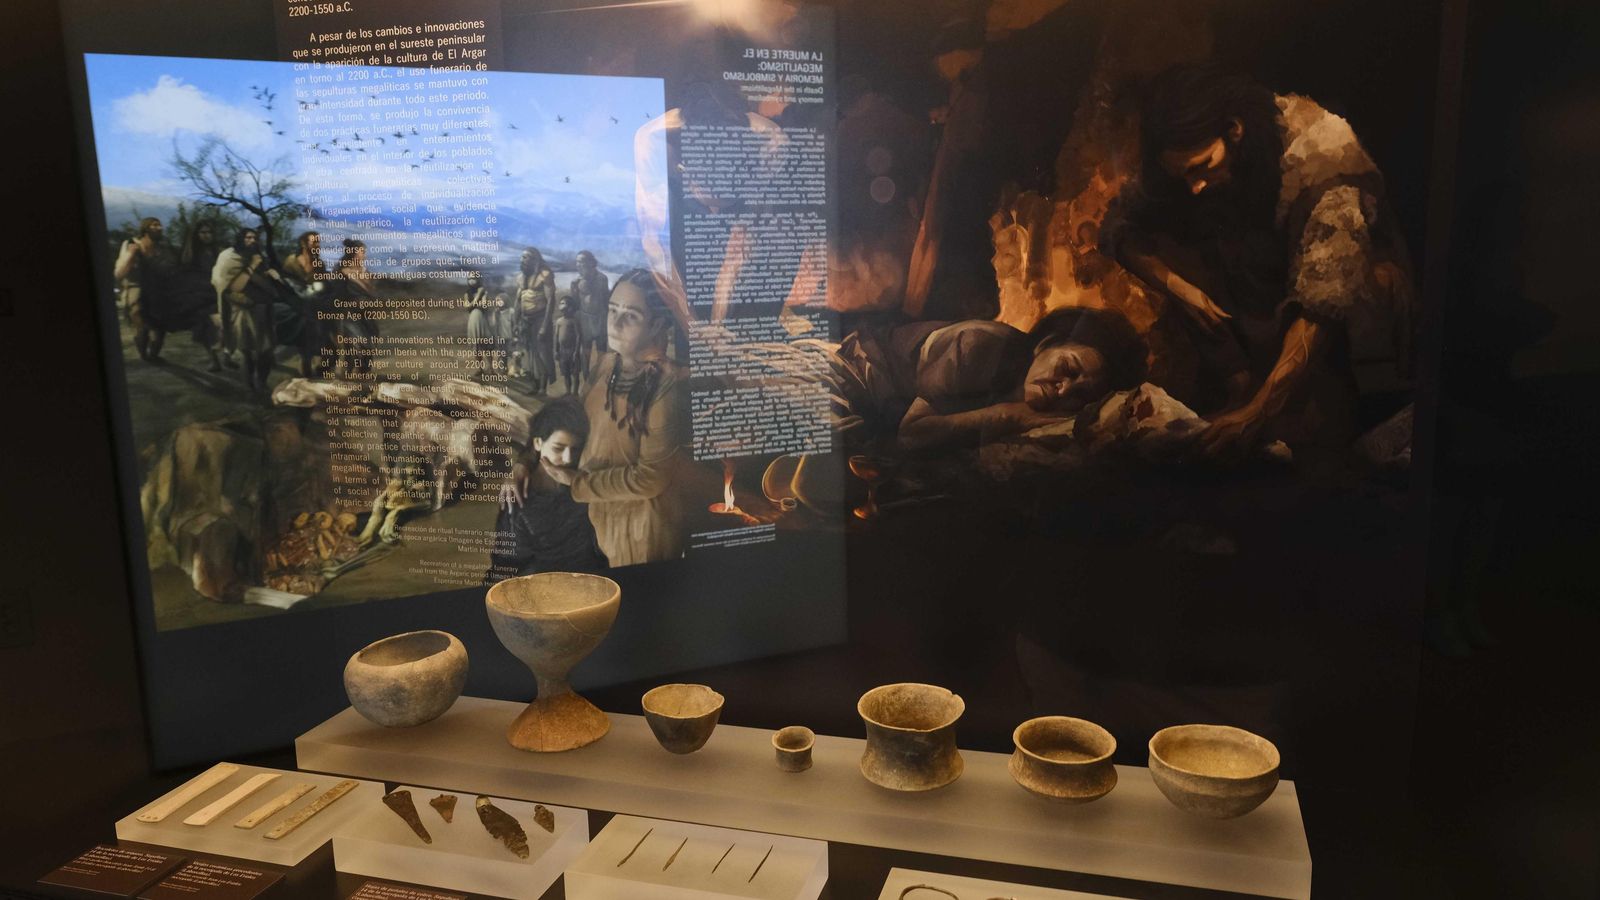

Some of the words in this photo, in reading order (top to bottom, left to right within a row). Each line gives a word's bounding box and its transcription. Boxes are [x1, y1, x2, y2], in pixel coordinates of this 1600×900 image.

[288, 3, 334, 16] 2200-1550
[336, 1, 353, 12] a.C.
[318, 32, 343, 43] pesar
[345, 29, 356, 39] de
[359, 27, 372, 38] los
[375, 24, 412, 37] cambios
[424, 18, 484, 33] innovaciones
[292, 48, 308, 59] que
[311, 47, 321, 56] se
[324, 41, 371, 57] produjeron
[374, 42, 385, 51] en
[388, 39, 397, 50] el
[400, 36, 433, 49] sureste
[436, 32, 486, 48] peninsular
[293, 62, 308, 71] con
[324, 56, 364, 70] aparición
[368, 54, 379, 65] de
[383, 54, 391, 64] la
[396, 51, 427, 63] cultura
[431, 50, 443, 60] de
[447, 48, 456, 59] El
[461, 46, 486, 60] Argar
[347, 69, 369, 80] 2200
[396, 66, 405, 76] el
[408, 67, 425, 76] uso
[429, 61, 471, 74] funerario
[475, 60, 487, 71] de
[428, 76, 467, 88] mantuvo
[471, 77, 488, 85] con
[428, 91, 448, 102] este
[403, 216, 411, 225] la
[421, 214, 474, 225] reutilización
[485, 213, 497, 223] de
[350, 229, 406, 240] monumentos
[470, 227, 498, 239] puede
[311, 257, 322, 266] de
[386, 256, 396, 265] de
[401, 257, 431, 267] grupos
[313, 270, 345, 280] cambio,
[389, 269, 426, 281] antiguas
[333, 298, 356, 307] Grave
[359, 298, 383, 309] goods
[385, 298, 425, 309] deposited
[427, 297, 454, 309] during
[316, 310, 344, 319] Bronze
[346, 310, 361, 321] Age
[363, 310, 409, 321] (2200-1550
[411, 310, 429, 321] BC).
[337, 334, 367, 345] Despite
[370, 334, 383, 343] the
[386, 334, 433, 343] innovations
[436, 334, 453, 343] that
[456, 334, 493, 344] occurred
[497, 335, 505, 344] in
[320, 346, 333, 355] the
[336, 346, 391, 355] south-eastern
[394, 347, 416, 355] Iberia
[419, 347, 437, 356] with
[440, 347, 453, 356] the
[456, 349, 506, 358] appearance
[321, 358, 329, 367] of
[335, 358, 348, 367] the
[354, 358, 361, 367] El
[367, 358, 389, 369] Argar
[395, 359, 423, 368] culture
[429, 359, 458, 368] around
[464, 359, 485, 369] 2200
[322, 369, 335, 378] the
[344, 370, 377, 381] funerary
[410, 371, 419, 380] of
[481, 372, 507, 381] tombs
[325, 405, 359, 414] different
[365, 406, 398, 417] funerary
[405, 407, 442, 418] practices
[326, 416, 339, 425] old
[344, 417, 376, 426] tradition
[382, 418, 398, 427] that
[469, 420, 510, 432] continuity
[327, 428, 336, 436] of
[341, 428, 377, 438] collective
[383, 430, 424, 441] megalithic
[328, 439, 363, 451] mortuary
[367, 441, 398, 452] practice
[472, 444, 512, 454] individual
[329, 451, 369, 460] intramural
[443, 455, 458, 464] The
[504, 457, 513, 466] of
[331, 462, 371, 474] megalithic
[455, 467, 466, 476] be
[474, 468, 514, 480] explained
[344, 474, 367, 483] terms
[372, 475, 380, 484] of
[449, 479, 458, 488] to
[463, 479, 476, 488] the
[333, 485, 341, 494] of
[347, 486, 369, 495] social
[437, 526, 453, 534] ritual
[454, 527, 482, 535] funerario
[484, 537, 516, 547] Esperanza
